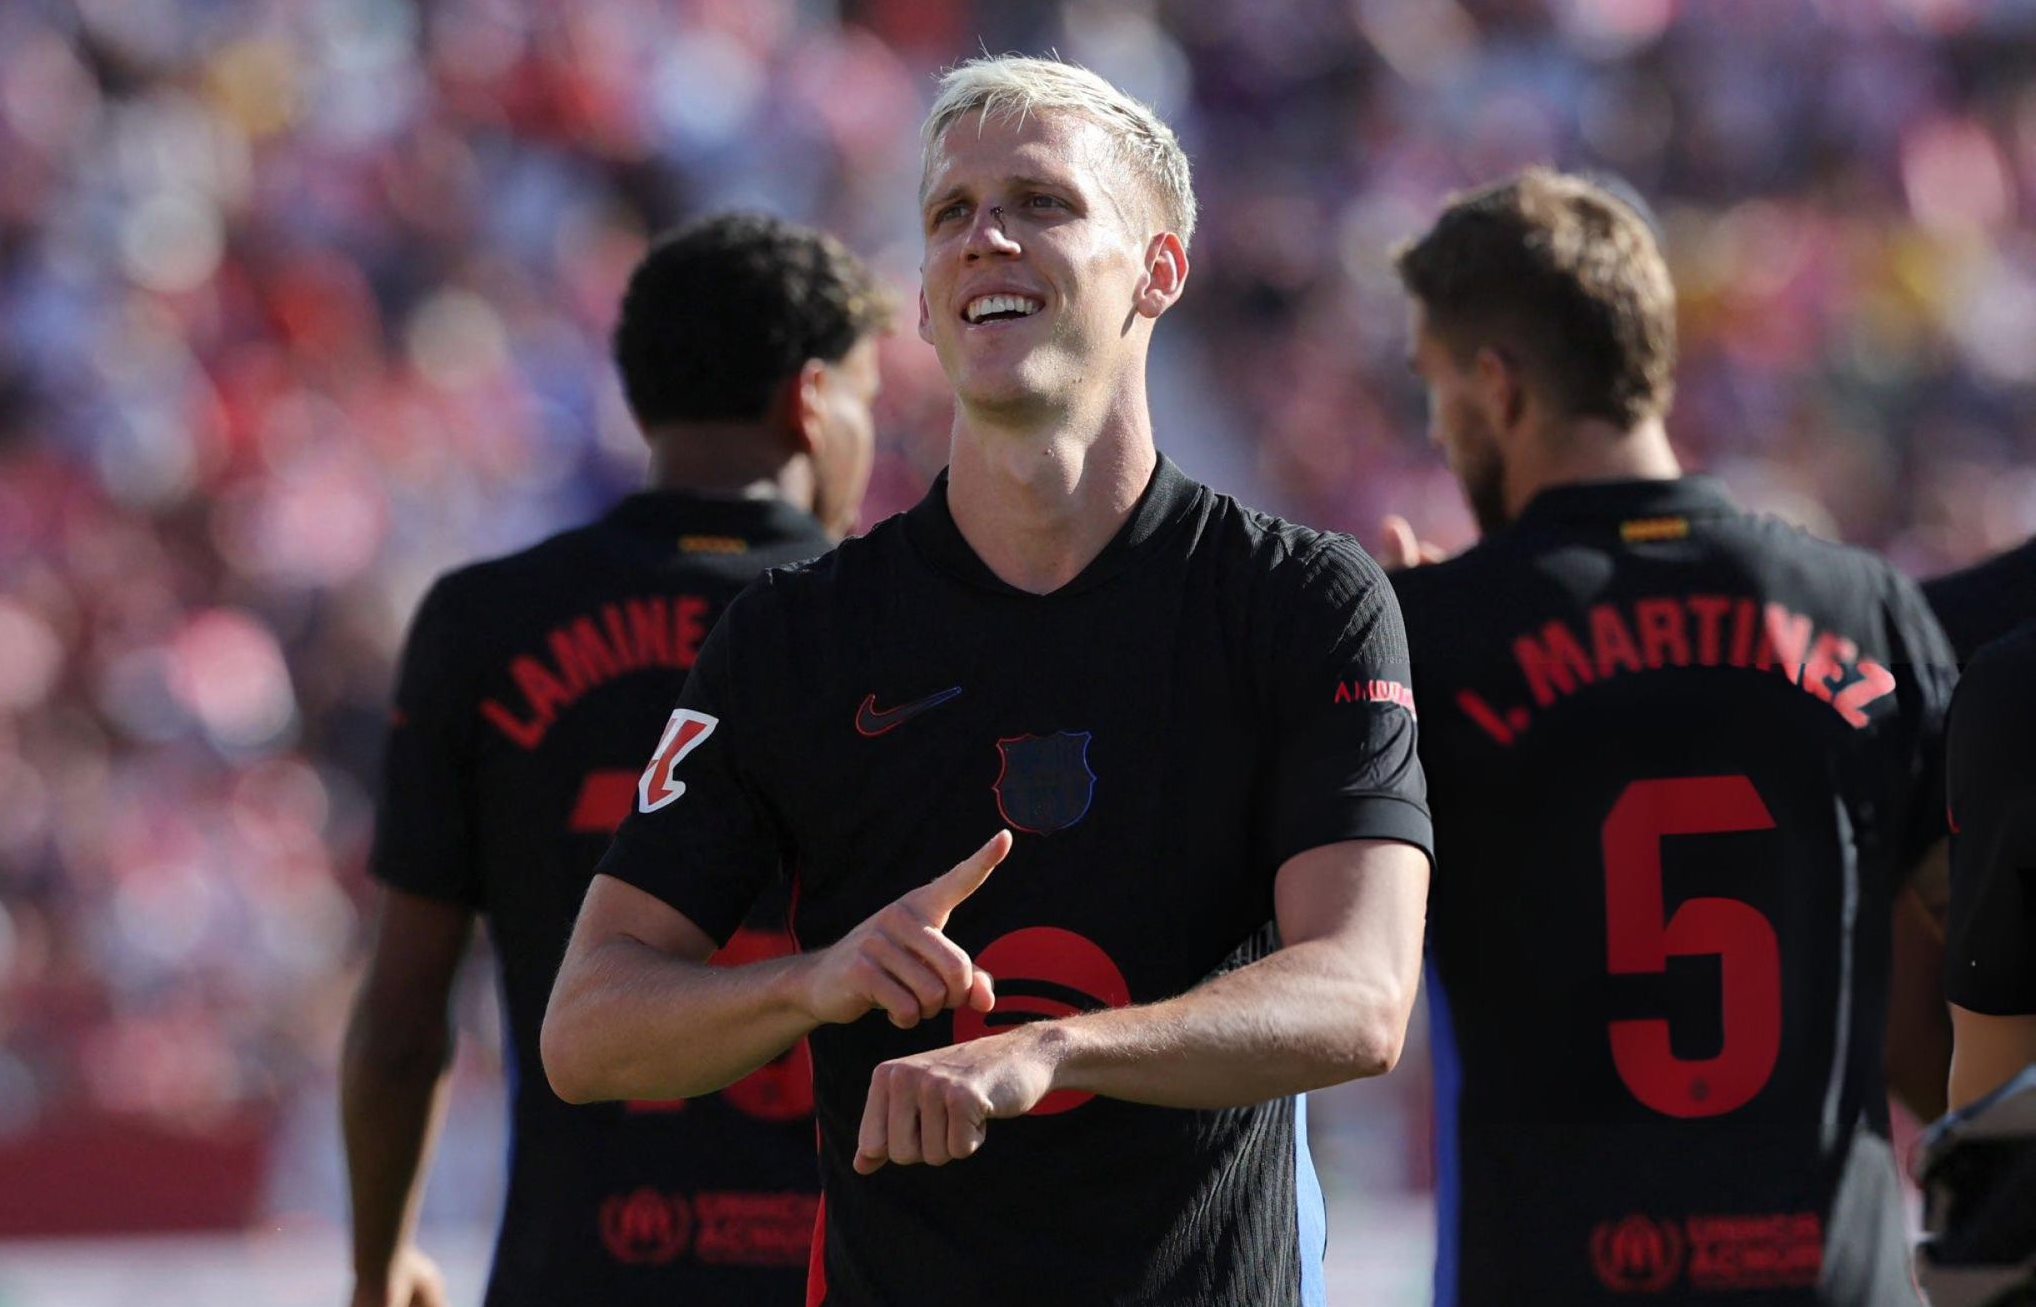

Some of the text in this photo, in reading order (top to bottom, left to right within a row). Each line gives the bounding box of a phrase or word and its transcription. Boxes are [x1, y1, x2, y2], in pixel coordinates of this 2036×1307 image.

[480, 595, 710, 751] LAMINE
[1513, 595, 1896, 729] MARTINEZ
[1602, 774, 1782, 1118] 5
